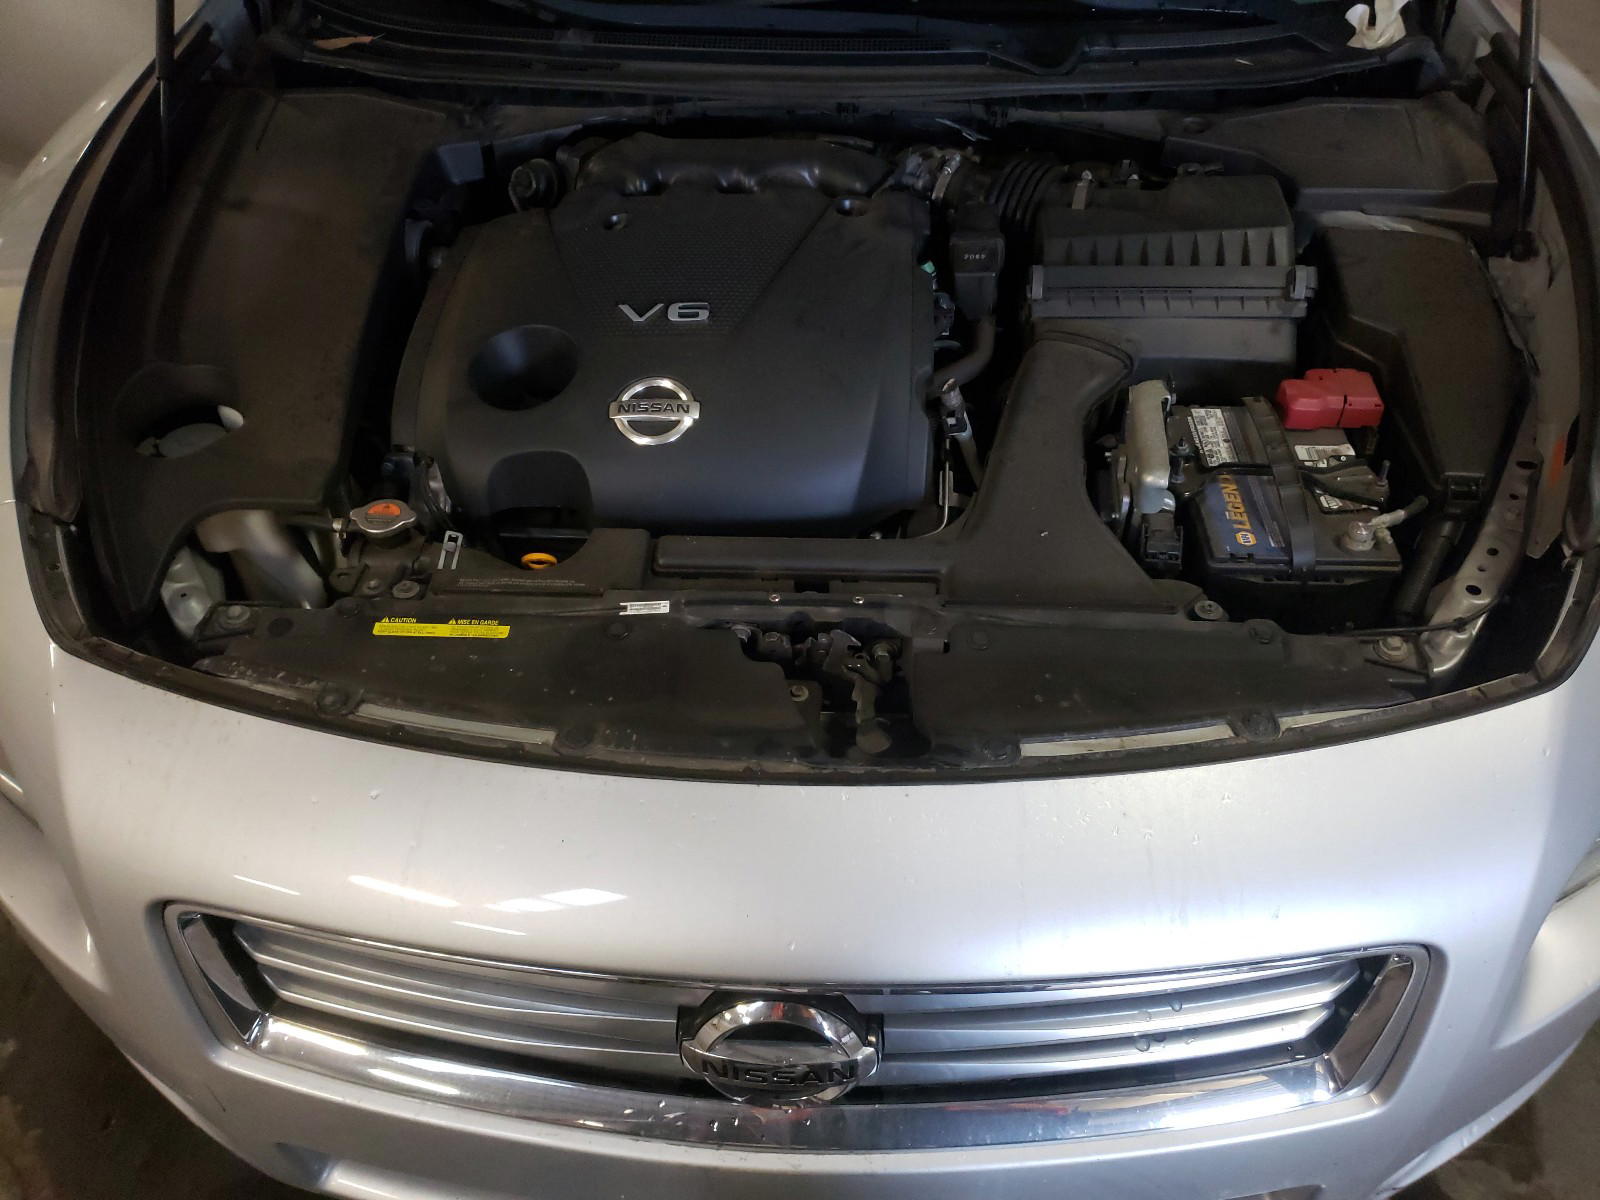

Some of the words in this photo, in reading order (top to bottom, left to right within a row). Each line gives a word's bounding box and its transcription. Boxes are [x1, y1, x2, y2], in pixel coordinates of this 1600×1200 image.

[618, 302, 710, 322] V6
[617, 402, 690, 414] NISSAN
[702, 1057, 859, 1086] NISSAN
